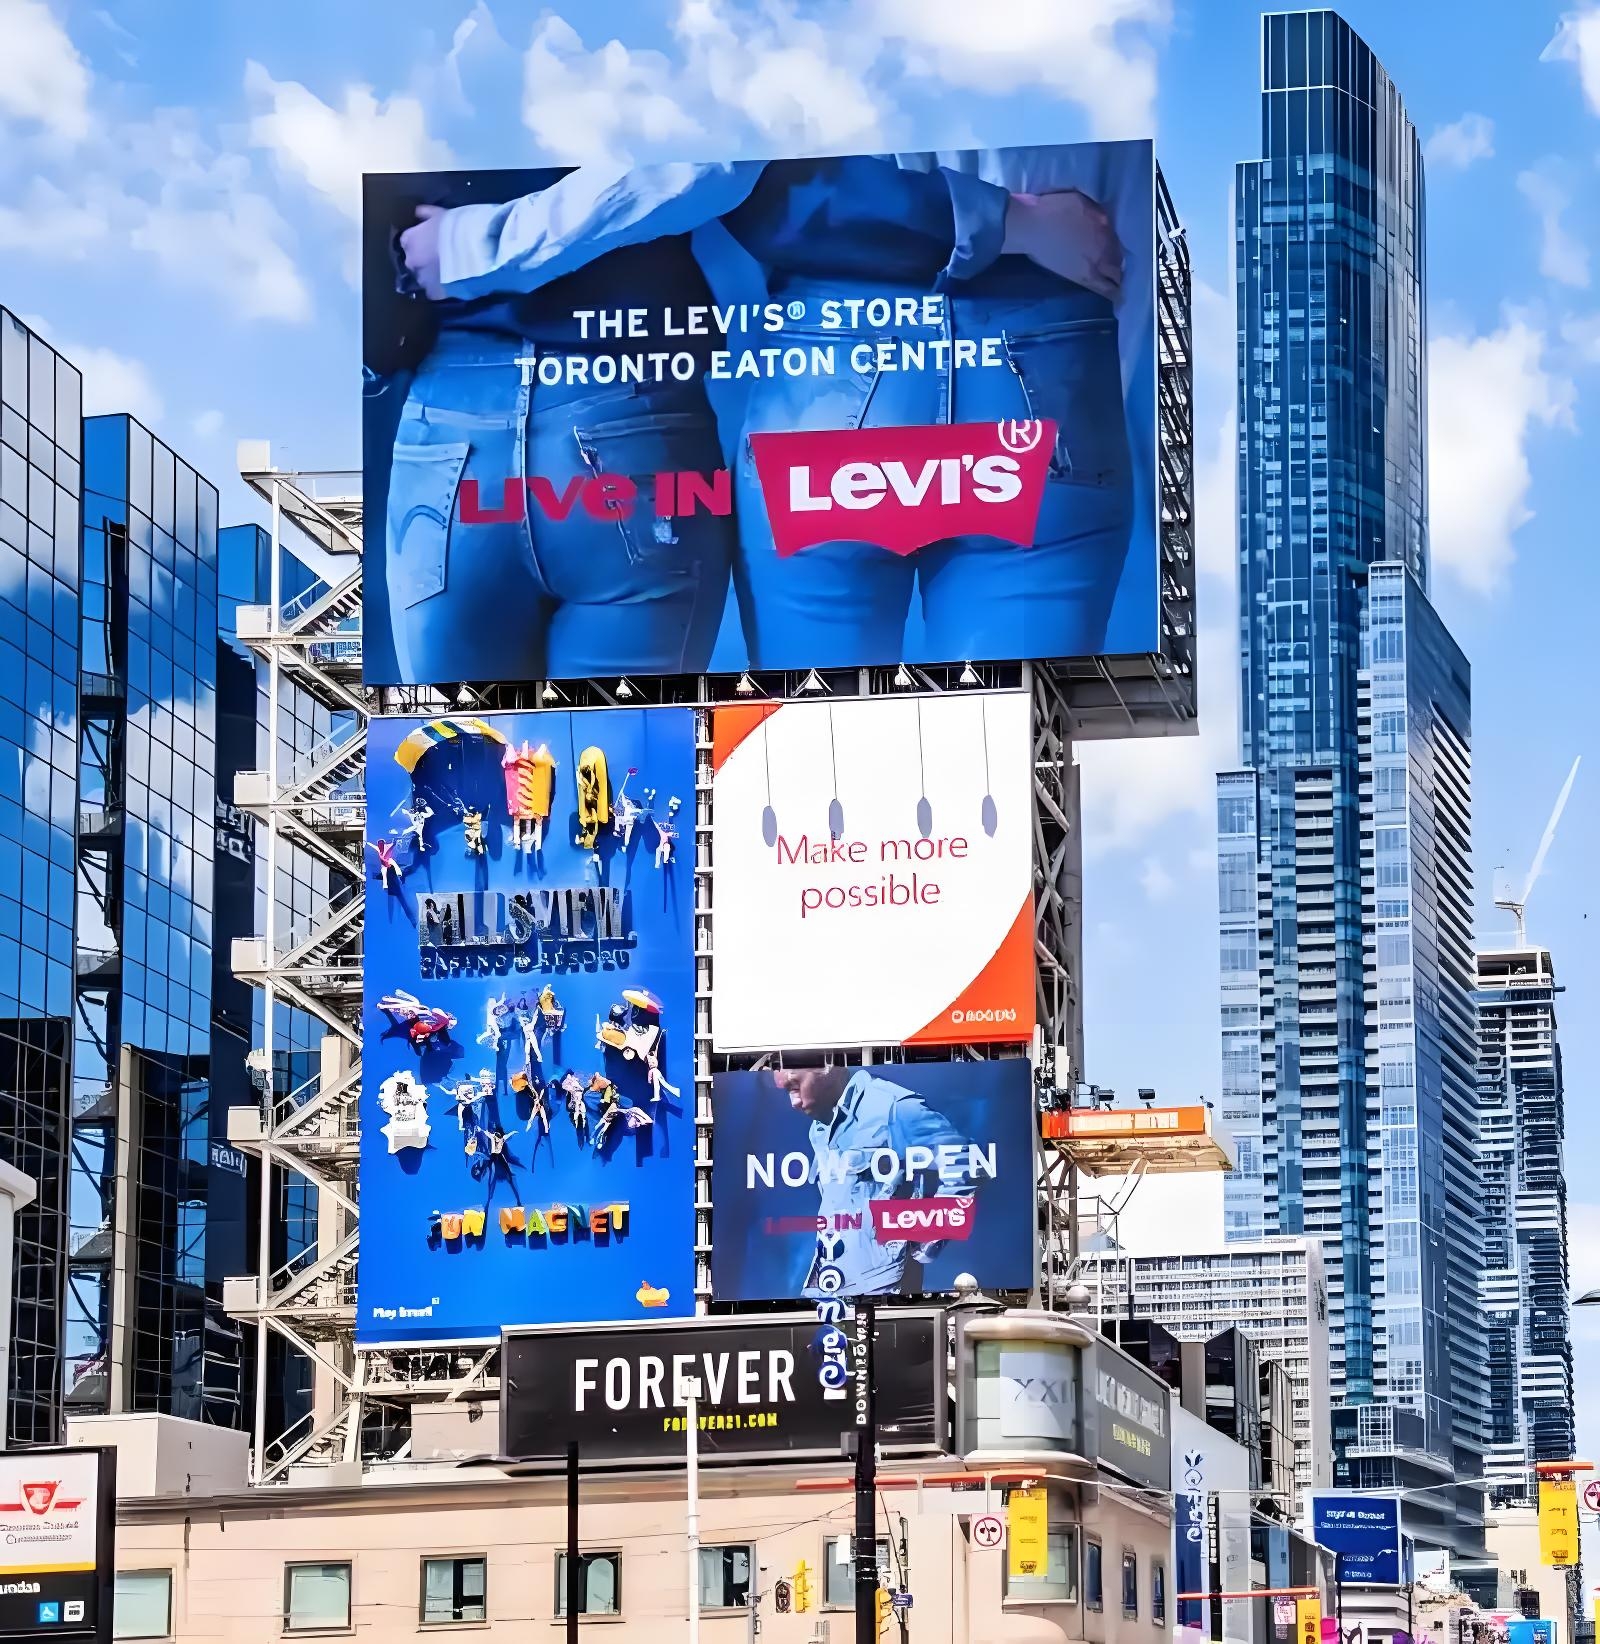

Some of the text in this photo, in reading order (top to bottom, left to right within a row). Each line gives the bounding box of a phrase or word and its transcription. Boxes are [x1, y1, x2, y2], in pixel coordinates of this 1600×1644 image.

[573, 309, 648, 339] THE
[820, 295, 945, 330] STORE
[519, 337, 1004, 386] TORONTO EATON CENTRE
[654, 468, 732, 518] IN
[776, 833, 969, 865] Make more
[801, 872, 941, 919] possible
[746, 1142, 998, 1189] NOW OPEN
[500, 1200, 630, 1237] MAGNET
[574, 1349, 796, 1412] FOREVER
[663, 1412, 778, 1432] FORVER21.COM
